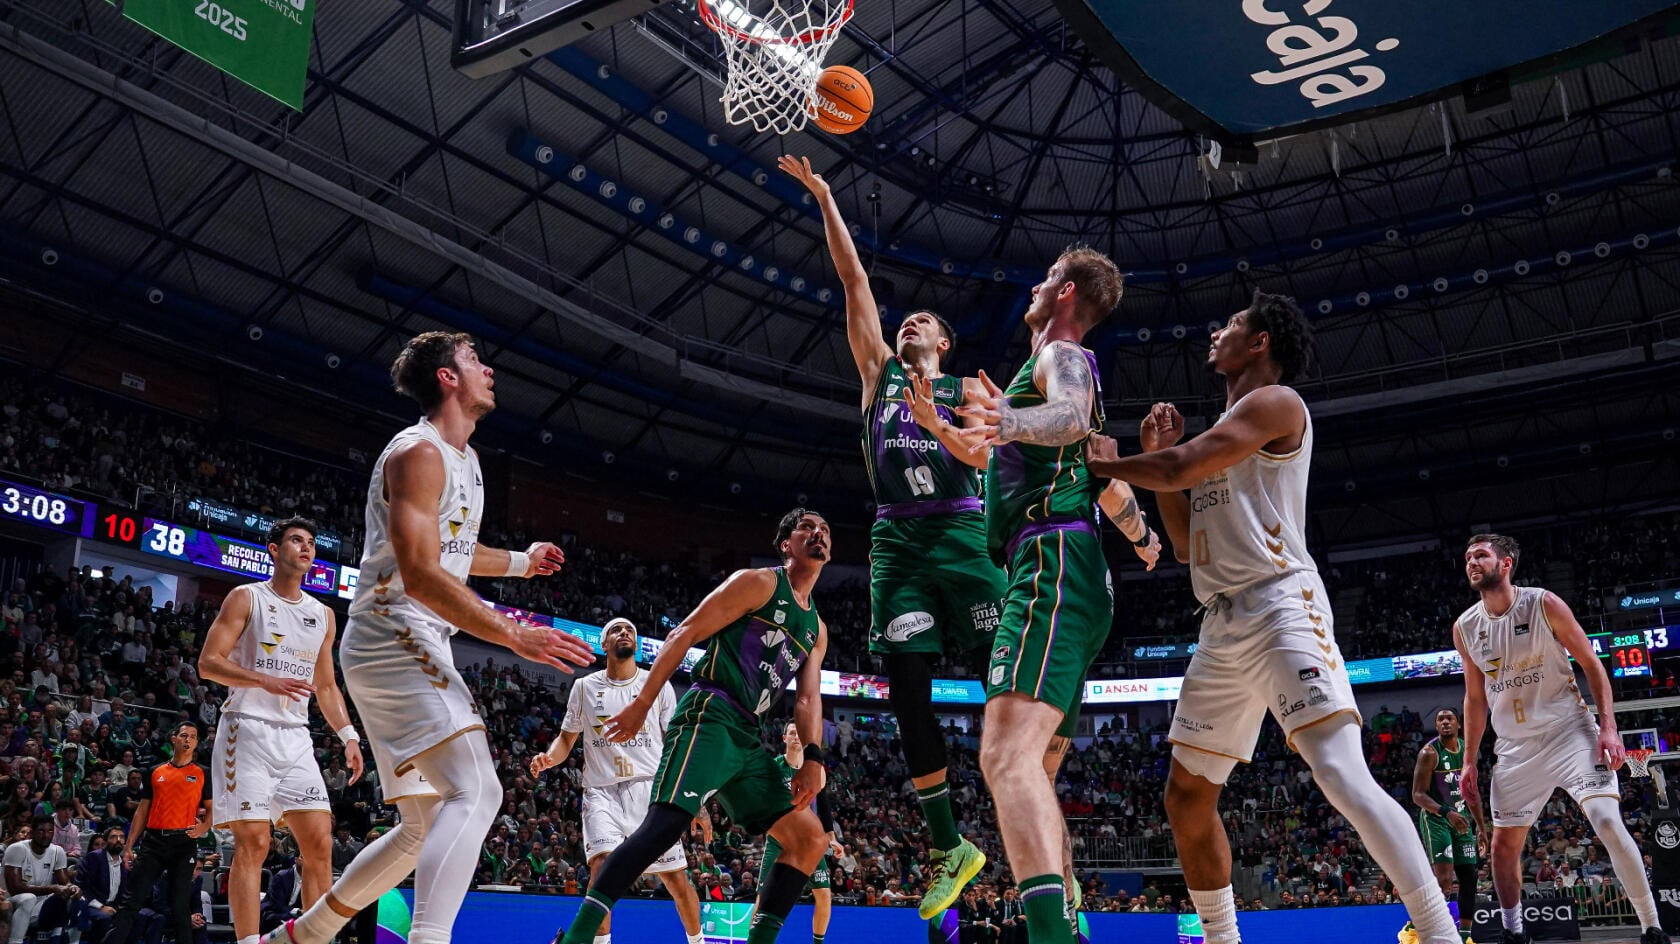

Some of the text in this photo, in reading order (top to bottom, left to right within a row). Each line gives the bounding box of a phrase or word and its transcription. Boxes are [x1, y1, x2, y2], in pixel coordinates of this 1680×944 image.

[195, 0, 248, 41] 2025
[904, 465, 935, 496] 19
[2, 487, 66, 526] 3:08
[105, 513, 136, 542] 10
[150, 522, 186, 557] 38
[221, 555, 239, 569] SAN
[240, 560, 267, 575] PABLO
[1633, 596, 1660, 606] Unicaja
[1613, 635, 1640, 646] 3:08
[1615, 648, 1643, 668] 10
[1105, 684, 1148, 694] ANSAN
[1513, 698, 1527, 724] 6
[1474, 905, 1572, 924] enesa
